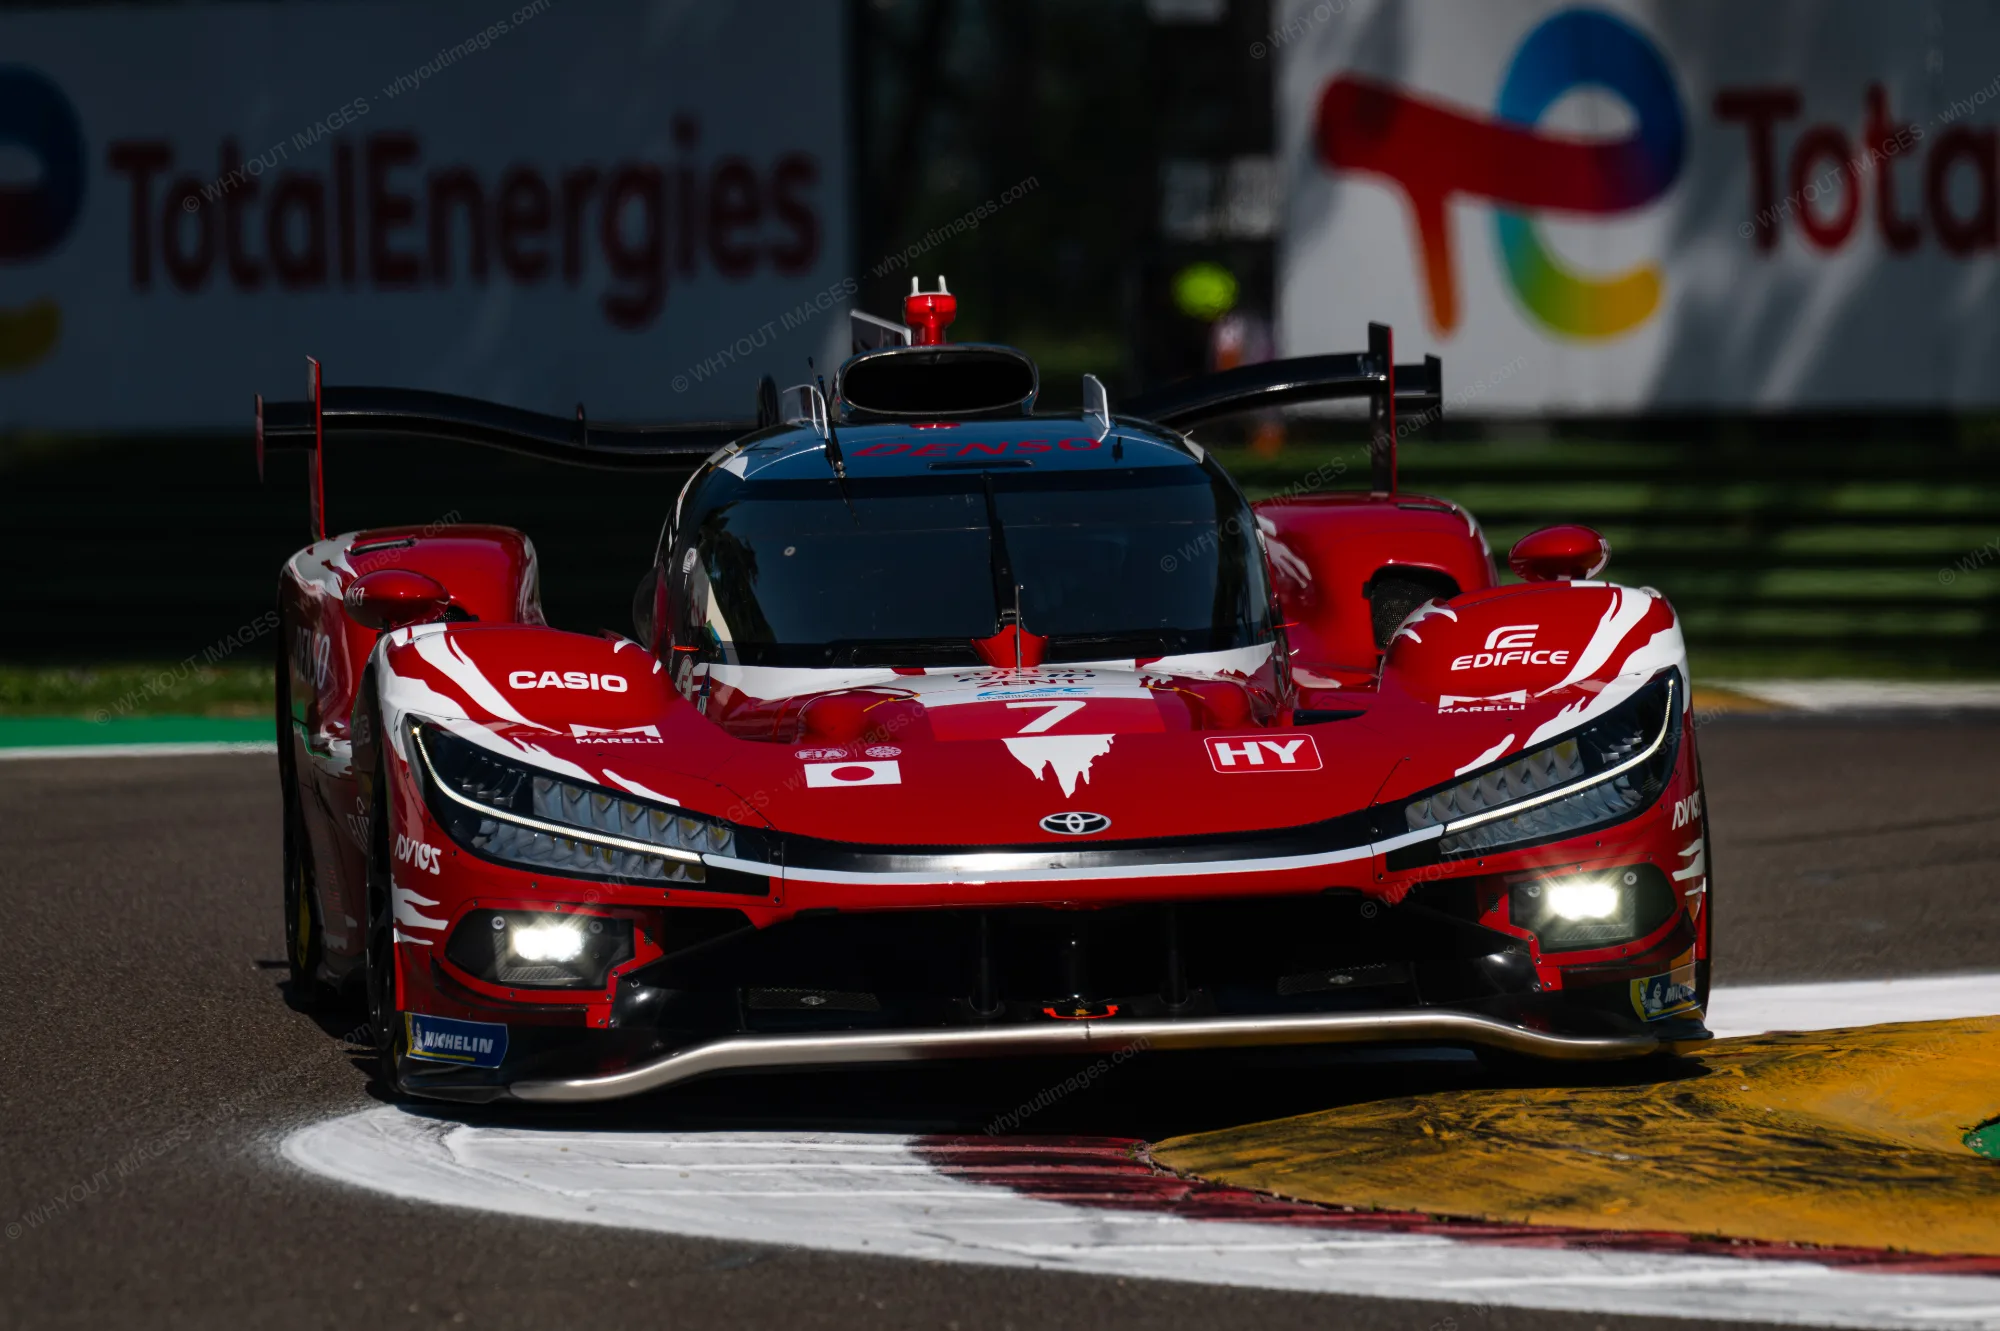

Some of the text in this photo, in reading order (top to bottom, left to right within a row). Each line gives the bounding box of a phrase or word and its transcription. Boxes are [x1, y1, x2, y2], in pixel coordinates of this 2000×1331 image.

[107, 109, 822, 331] TotalEnergies
[850, 437, 1103, 457] DENSO
[1450, 650, 1570, 671] EDIFICE
[508, 671, 628, 693] CASIO
[975, 679, 1083, 689] ZENT
[1005, 700, 1087, 734] 7
[1437, 704, 1526, 715] MARELLI
[575, 737, 665, 745] MARELLI
[796, 749, 844, 760] FIA
[1214, 739, 1305, 766] HY
[423, 1030, 495, 1054] MICHELIN
